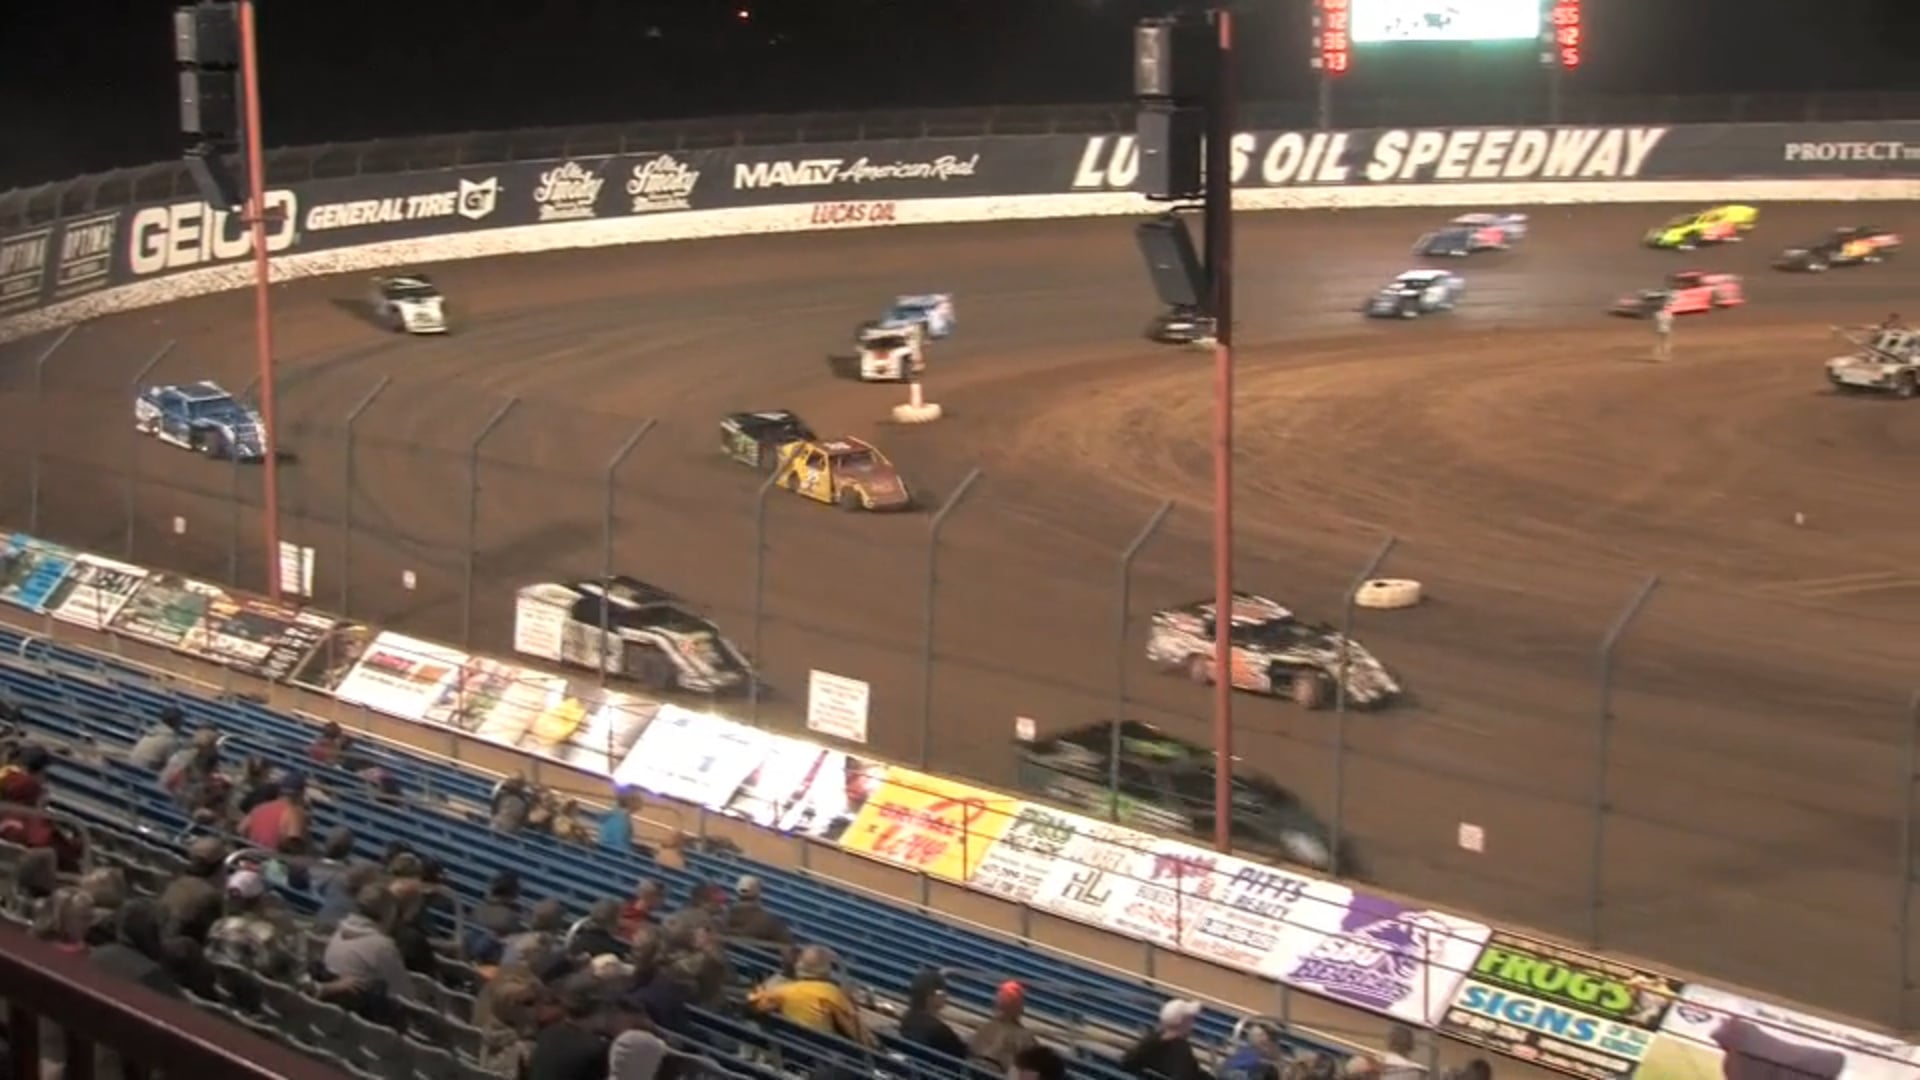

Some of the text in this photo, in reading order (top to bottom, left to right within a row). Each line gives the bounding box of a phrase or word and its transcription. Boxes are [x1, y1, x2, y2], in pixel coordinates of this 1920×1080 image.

[1262, 132, 1349, 184] OIL
[1366, 128, 1667, 181] SPEEDWAY
[1784, 141, 1904, 161] PROTECT
[130, 190, 297, 274] GEICO
[306, 191, 458, 231] GENERAL TIRE
[810, 202, 868, 225] LUCAS
[1460, 985, 1600, 1042] SIGNS
